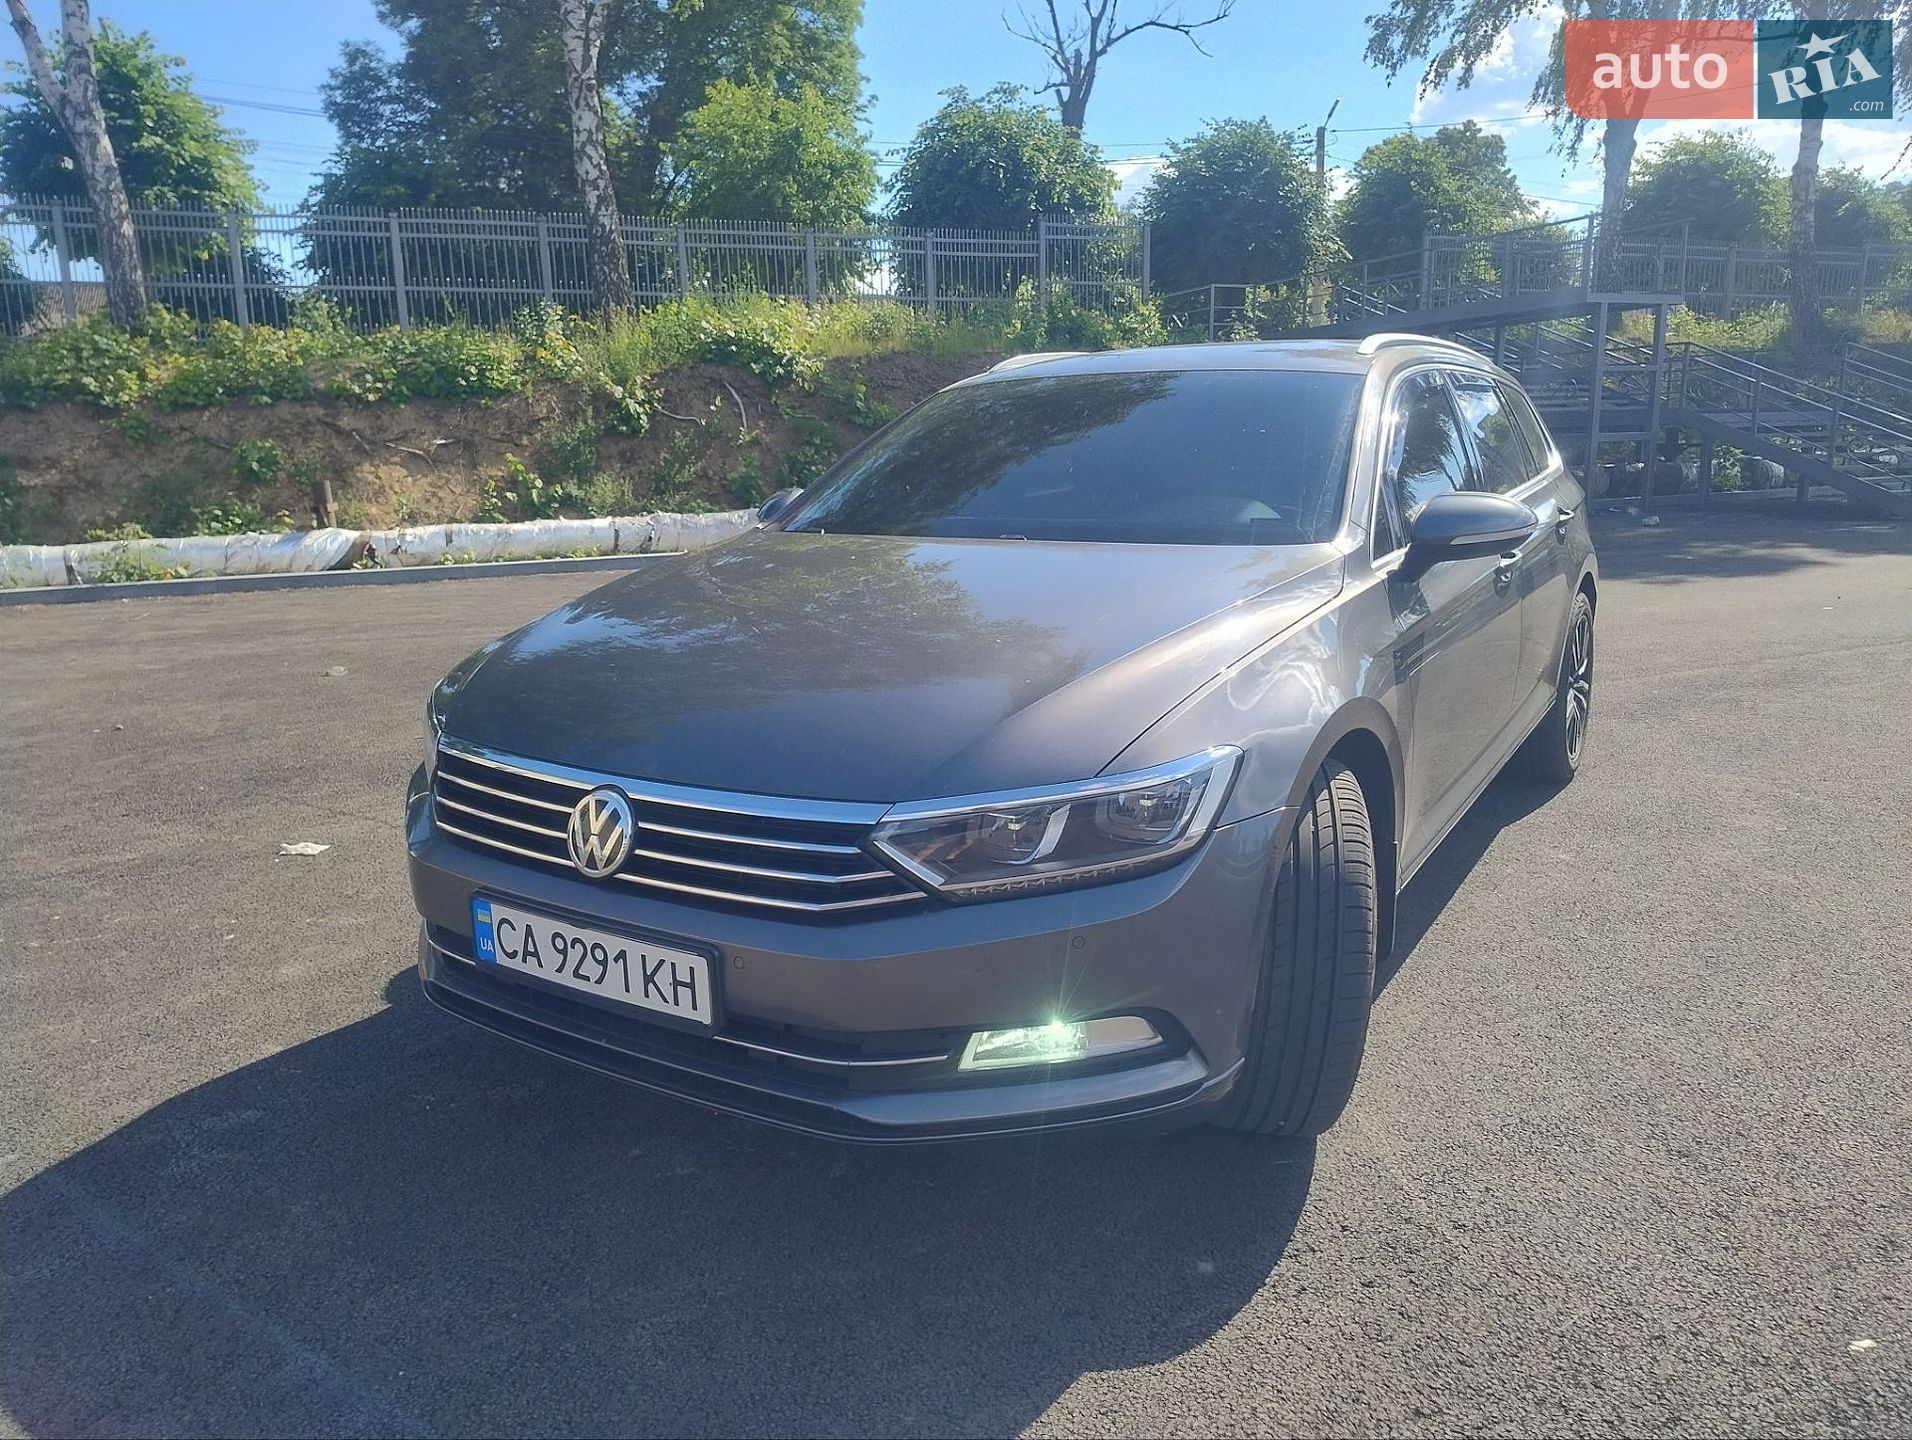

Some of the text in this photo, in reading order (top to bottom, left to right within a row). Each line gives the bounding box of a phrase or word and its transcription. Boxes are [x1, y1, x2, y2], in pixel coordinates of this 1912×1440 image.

[480, 936, 495, 953] UA
[496, 917, 698, 1011] CA 9291 KH
